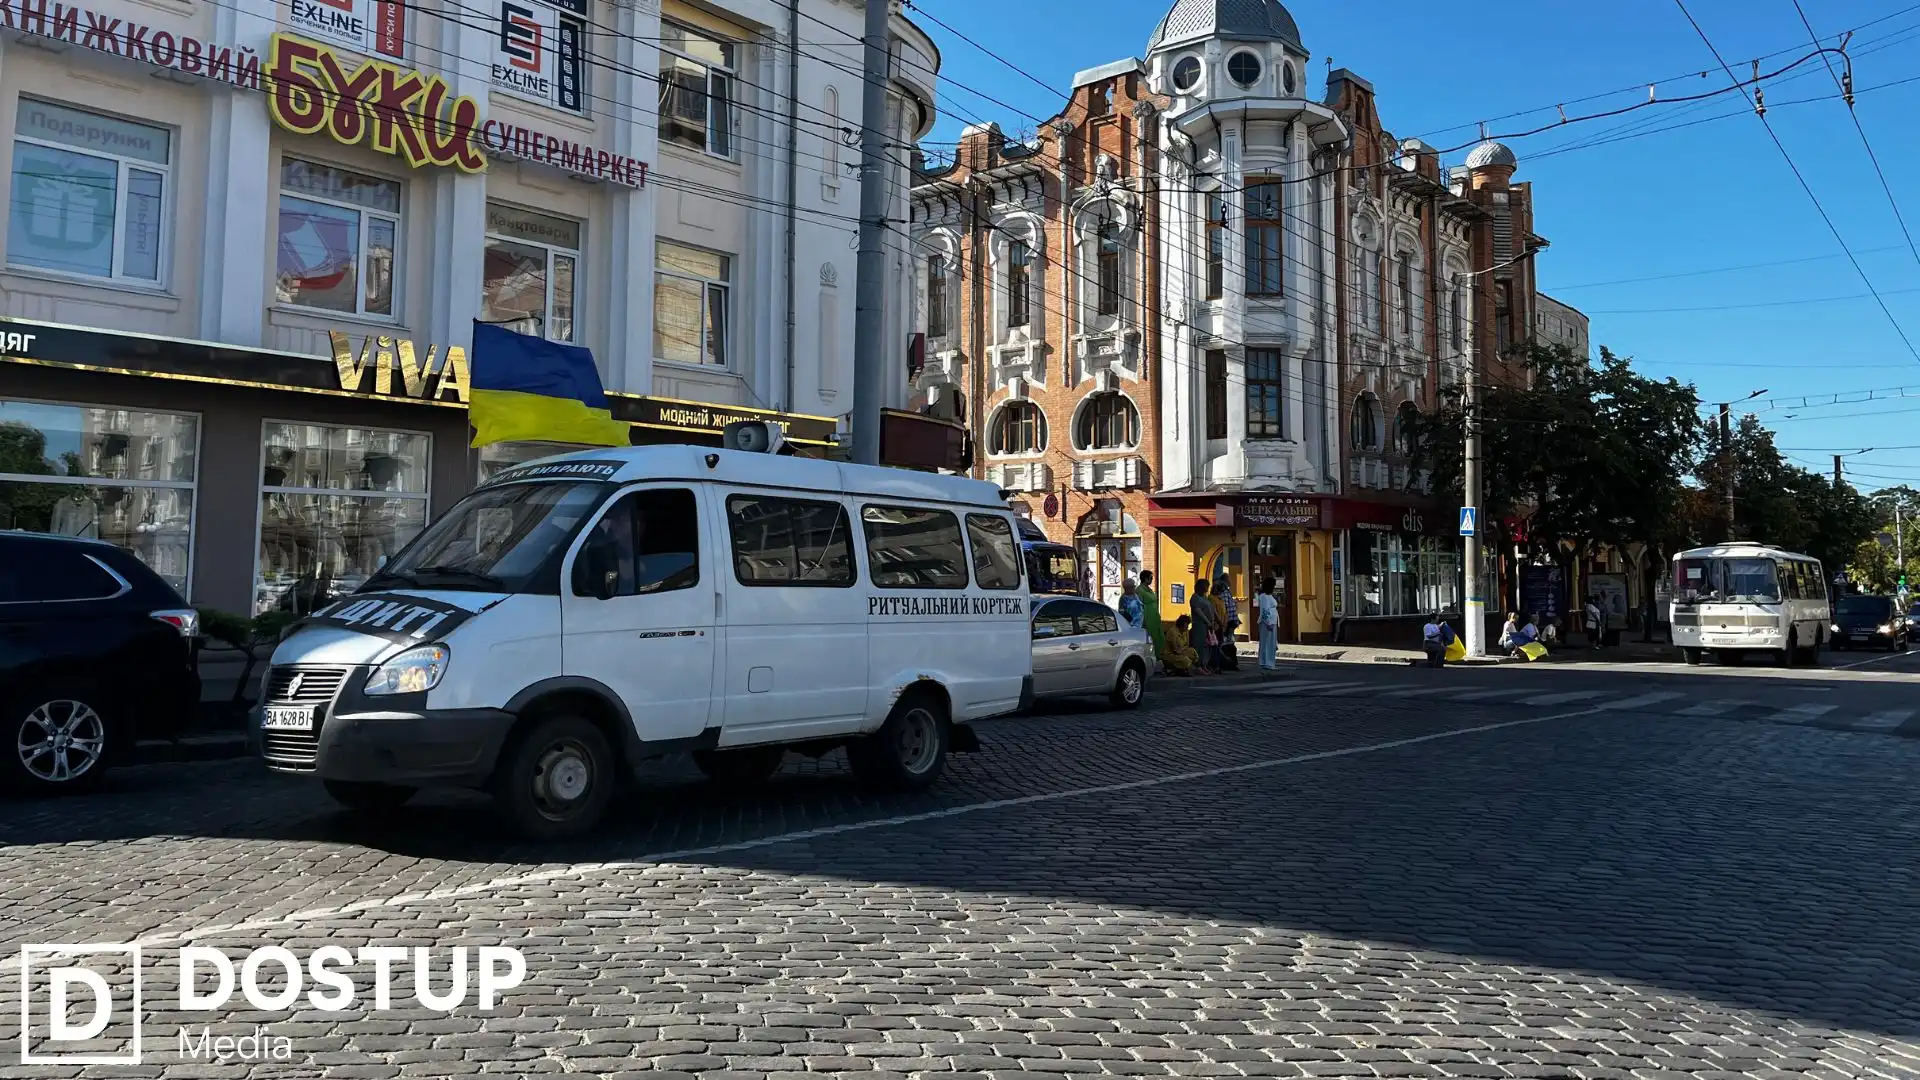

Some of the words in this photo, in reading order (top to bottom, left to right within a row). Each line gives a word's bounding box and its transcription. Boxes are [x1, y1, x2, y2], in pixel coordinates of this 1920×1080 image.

[291, 0, 363, 35] EXLINE
[491, 63, 548, 94] EXLINE
[30, 109, 151, 151] Подарунки
[482, 119, 649, 188] СУПЕРМАРКЕТ
[490, 212, 570, 241] Канцтовари
[660, 408, 709, 426] МОДНИЙ
[1402, 507, 1424, 532] elis
[330, 599, 455, 639] ЩИТІ
[868, 595, 970, 616] РИТУАЛЬНИЙ
[972, 597, 1022, 616] КОРТЕЖ
[280, 711, 297, 725] 1628
